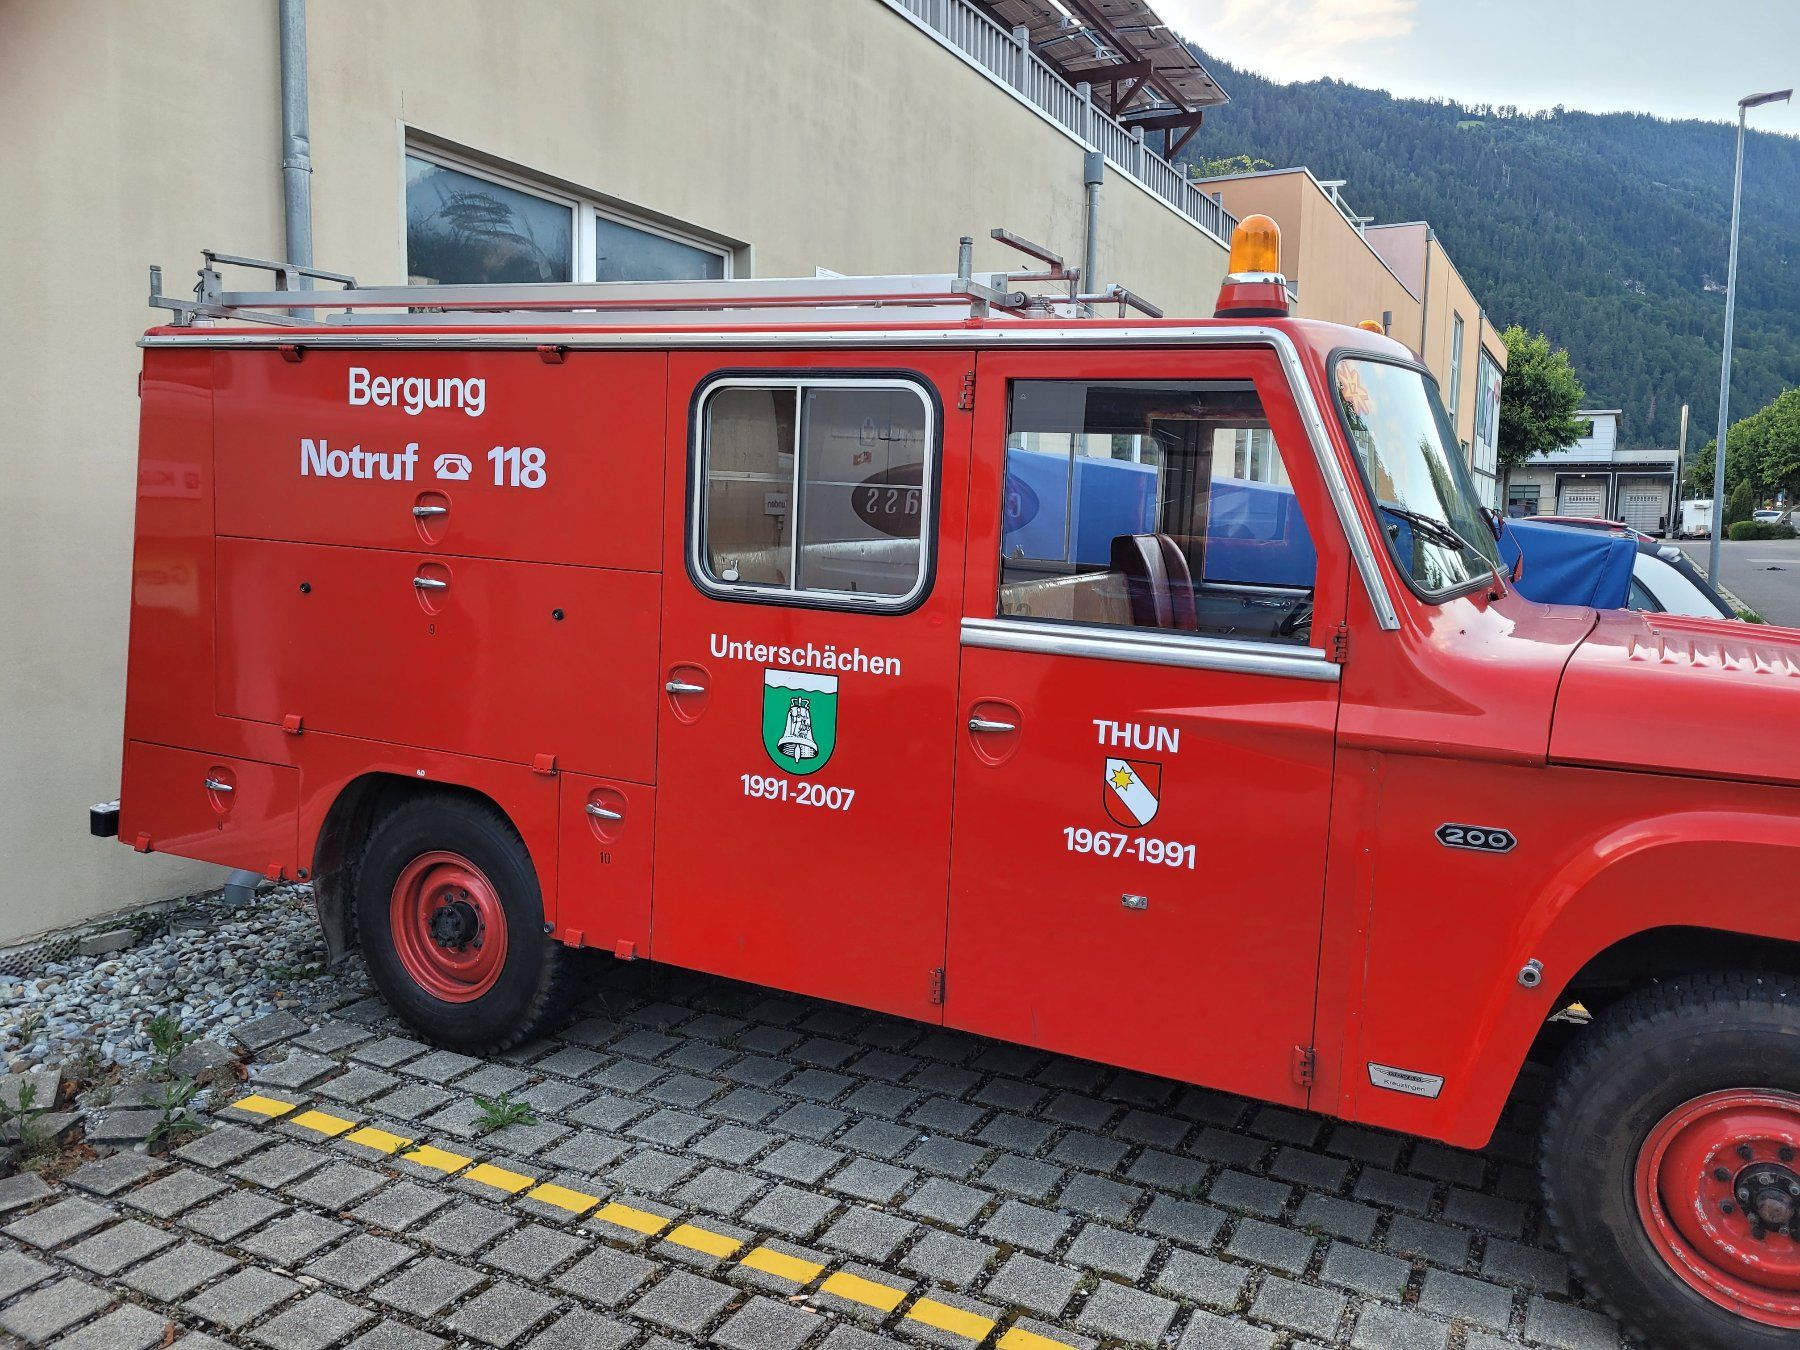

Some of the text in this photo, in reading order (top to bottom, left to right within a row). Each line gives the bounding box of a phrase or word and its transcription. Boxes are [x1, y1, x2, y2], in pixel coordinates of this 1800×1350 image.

[349, 367, 487, 417] Bergung
[300, 438, 547, 489] Notruf 118
[429, 623, 435, 635] 9
[709, 633, 901, 676] Unterschächen
[1092, 719, 1181, 754] THUN
[740, 772, 856, 812] 1991-2007
[600, 851, 611, 865] 10
[1063, 826, 1197, 870] 1967-1991
[1445, 828, 1508, 848] 200
